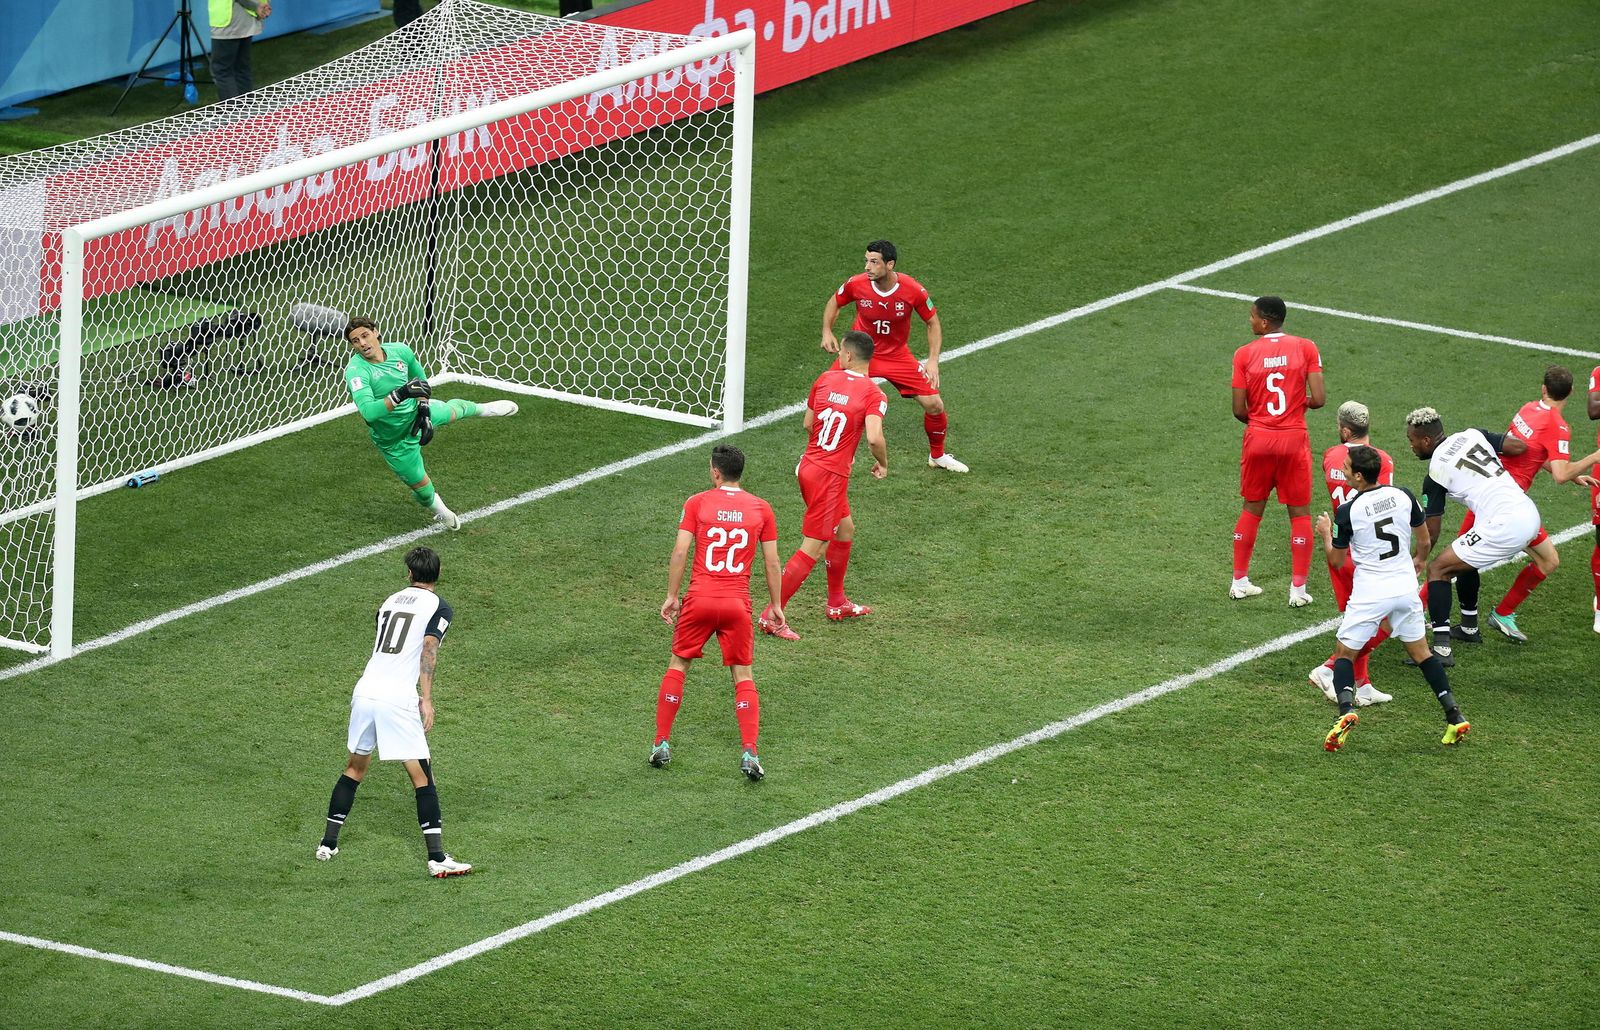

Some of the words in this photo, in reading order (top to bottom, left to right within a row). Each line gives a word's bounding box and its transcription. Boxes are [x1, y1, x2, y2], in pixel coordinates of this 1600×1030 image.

[872, 319, 891, 335] 15
[1266, 371, 1287, 416] 5
[816, 407, 848, 452] 10
[1455, 443, 1506, 478] 19
[716, 510, 743, 523] SCHÄR
[1372, 496, 1397, 514] BORGES
[705, 526, 749, 573] 22
[1374, 516, 1400, 560] 5
[375, 610, 417, 655] 10
